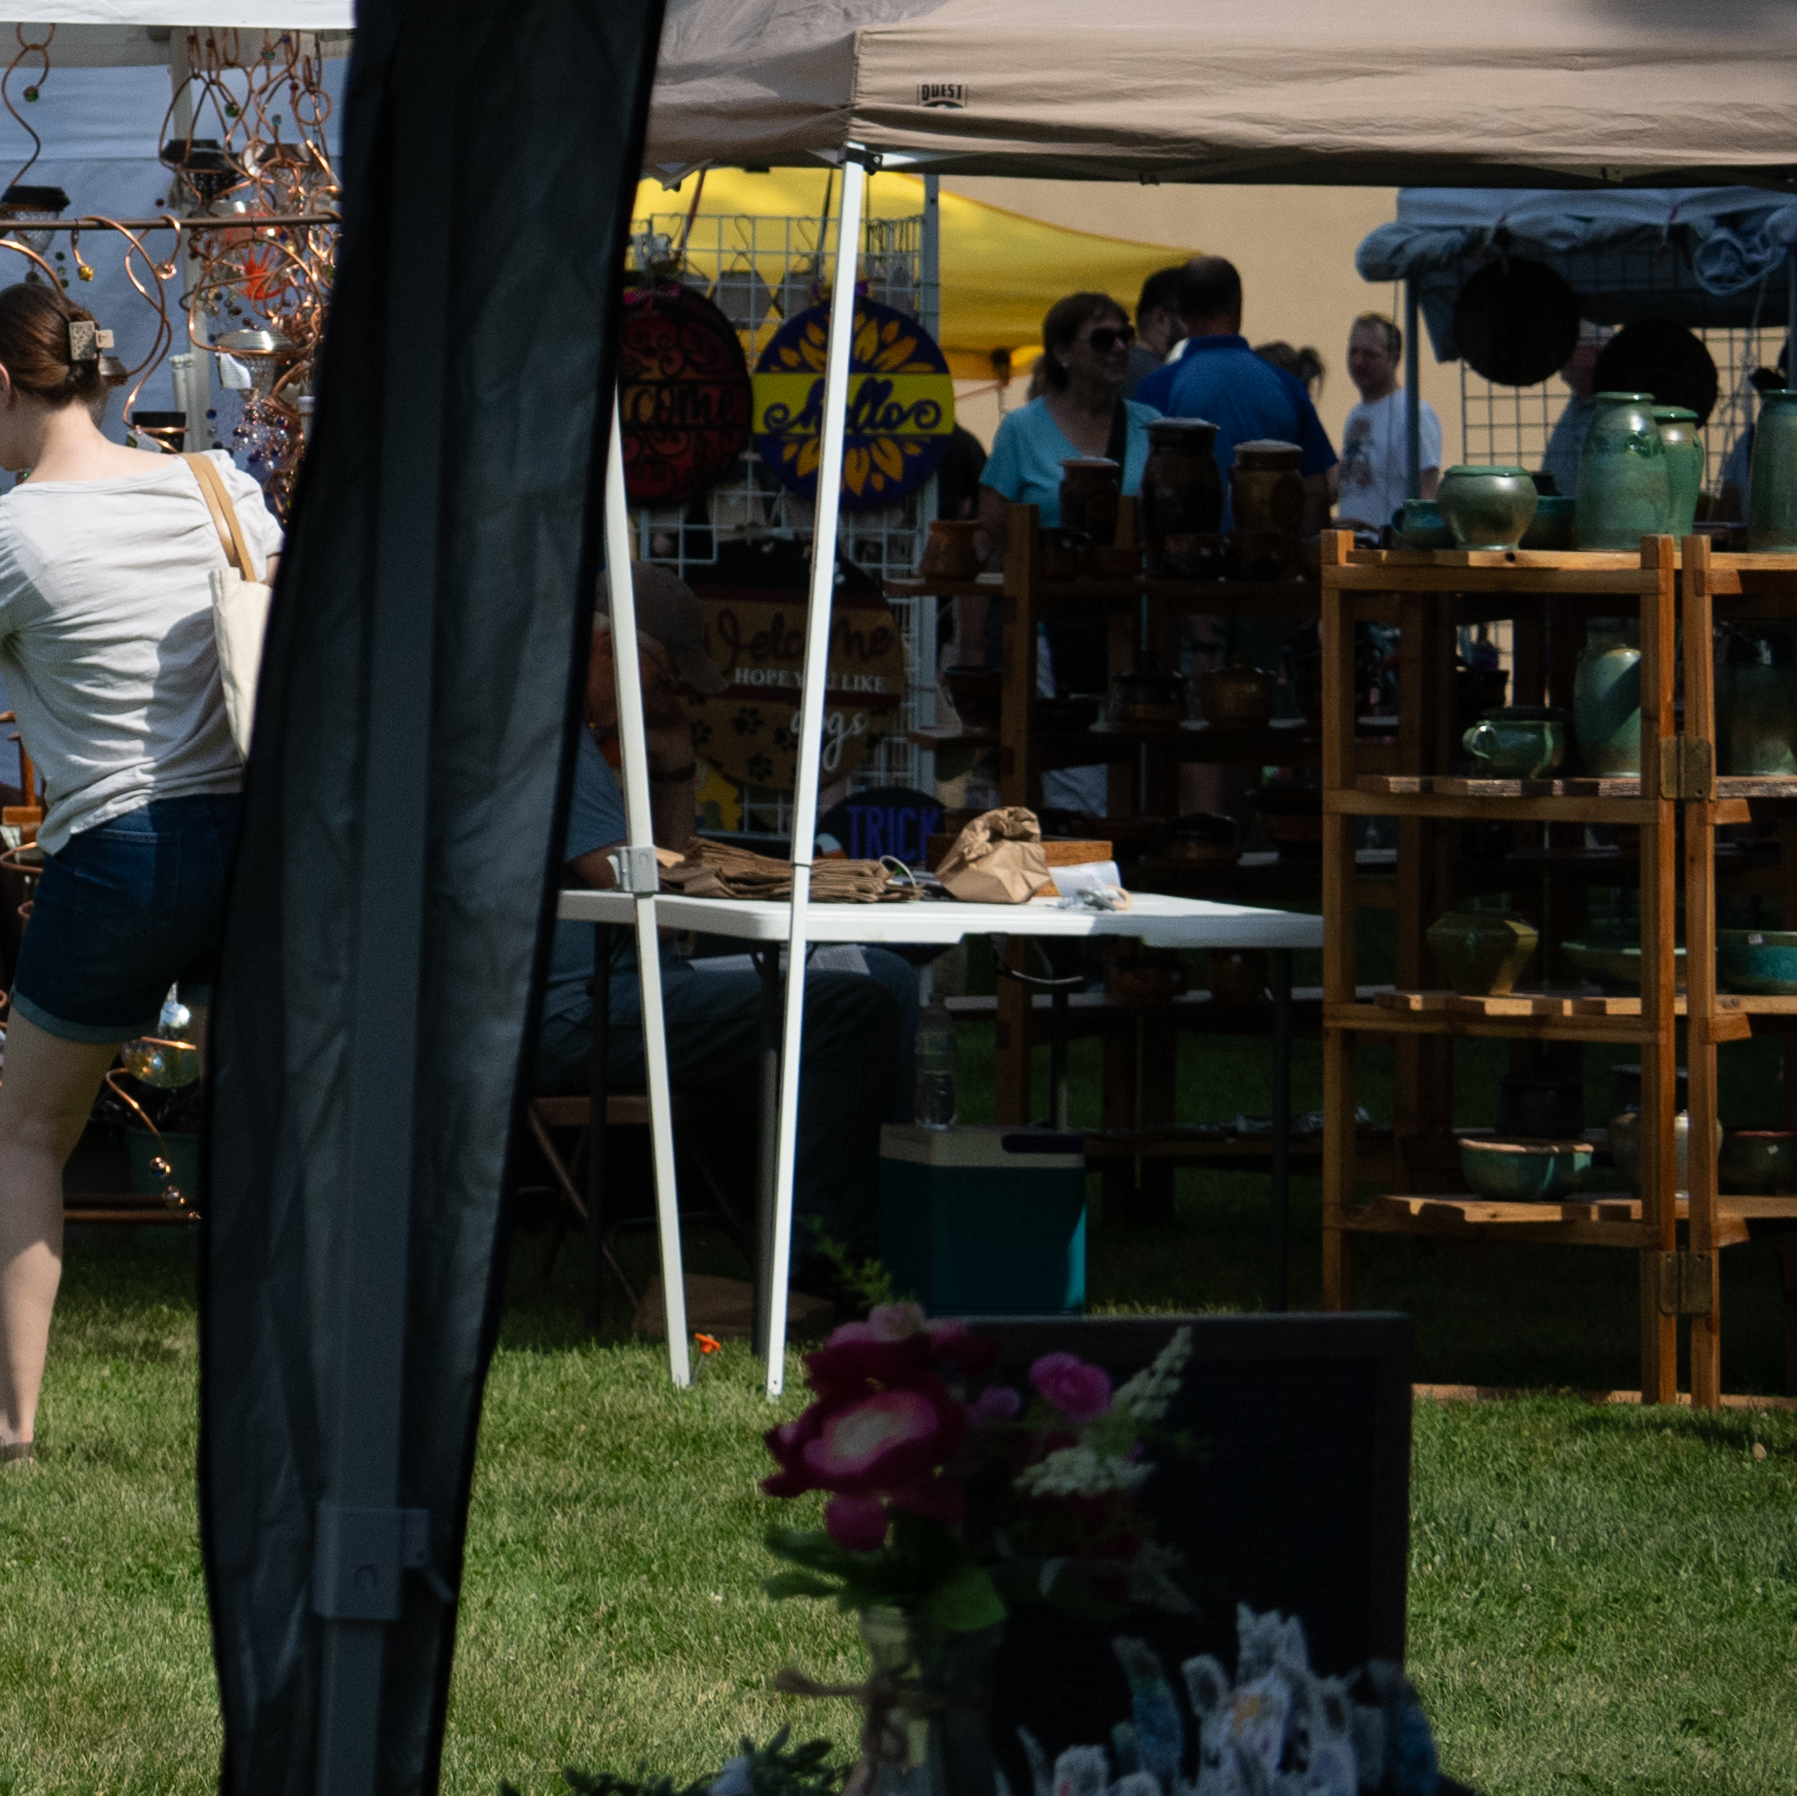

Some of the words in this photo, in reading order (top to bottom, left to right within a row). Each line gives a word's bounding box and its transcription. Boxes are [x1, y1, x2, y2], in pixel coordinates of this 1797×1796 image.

[921, 84, 963, 101] QUEST
[763, 376, 942, 433] hllo
[704, 609, 893, 676] Welcme
[734, 667, 791, 688] HOPE
[842, 673, 886, 693] LIKE
[845, 805, 941, 864] TRICK
